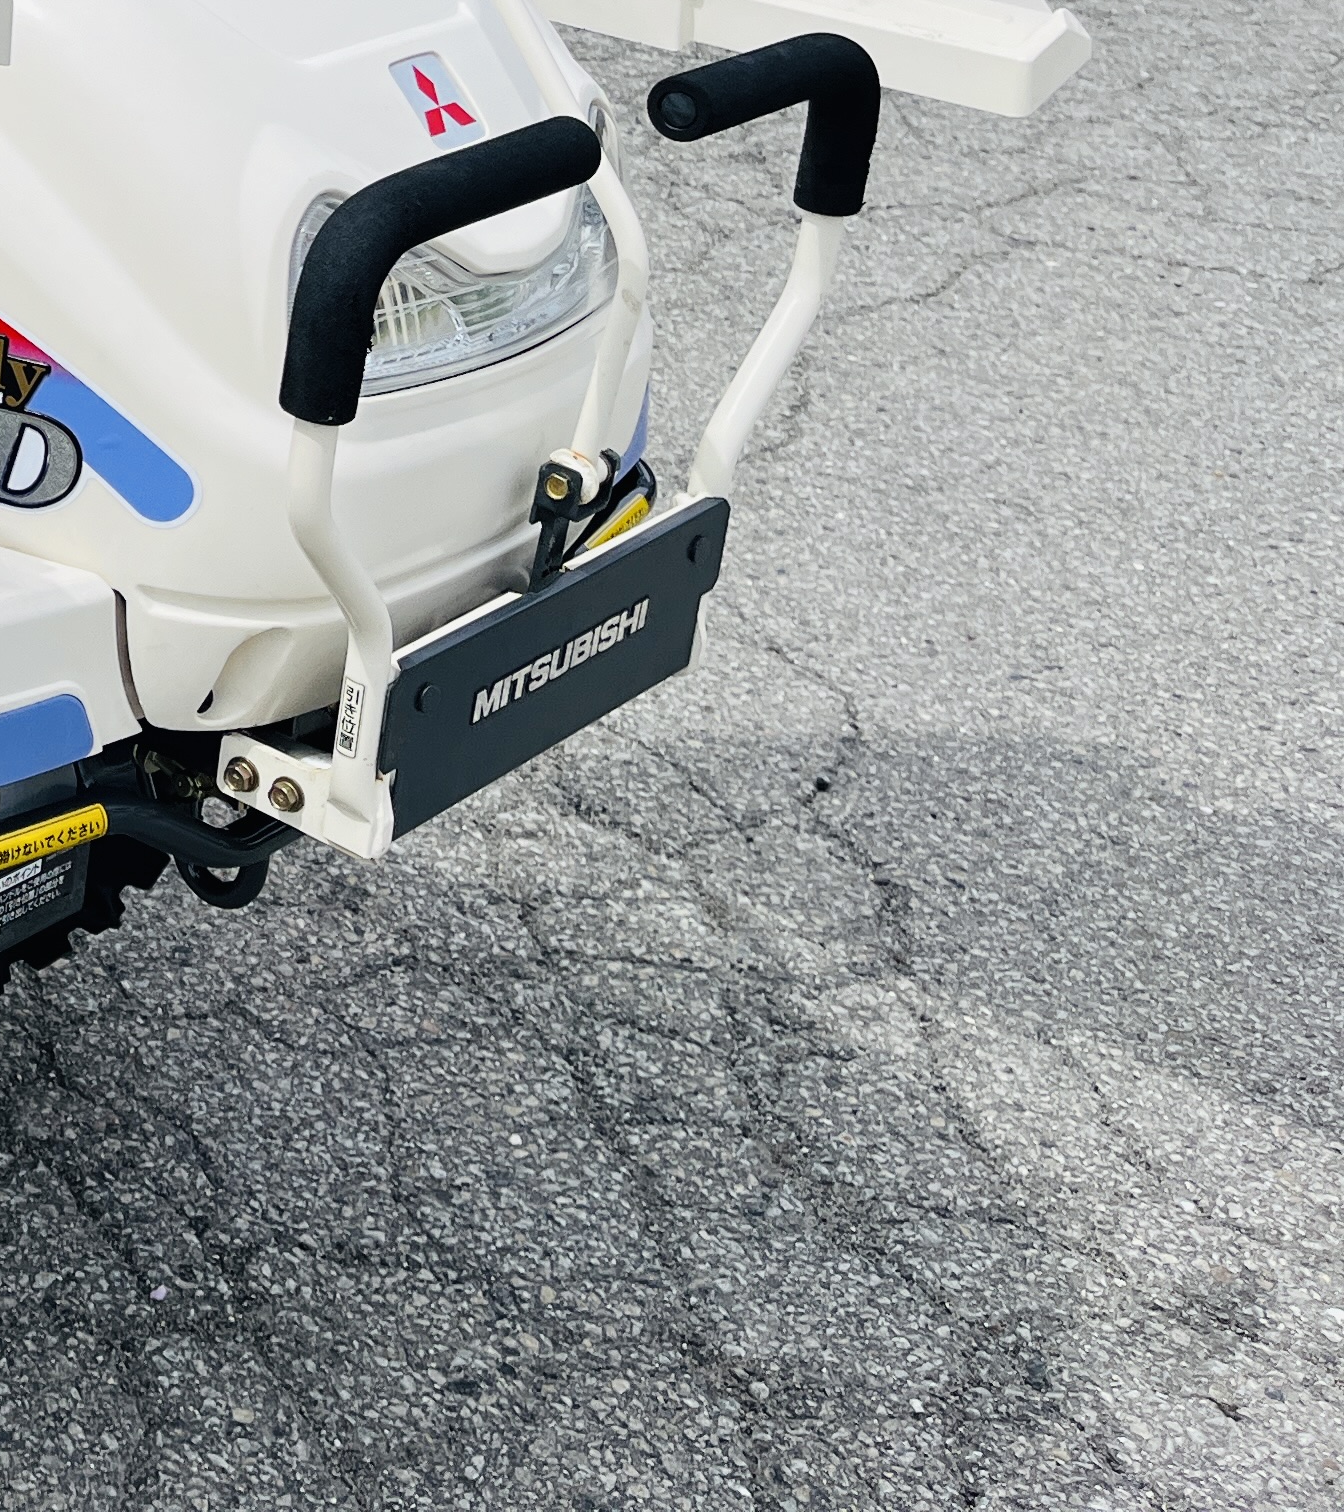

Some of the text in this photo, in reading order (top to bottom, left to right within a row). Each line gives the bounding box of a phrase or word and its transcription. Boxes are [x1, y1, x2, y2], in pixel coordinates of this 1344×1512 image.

[471, 596, 650, 724] MITSUBISHI
[339, 685, 360, 751] 引き位置
